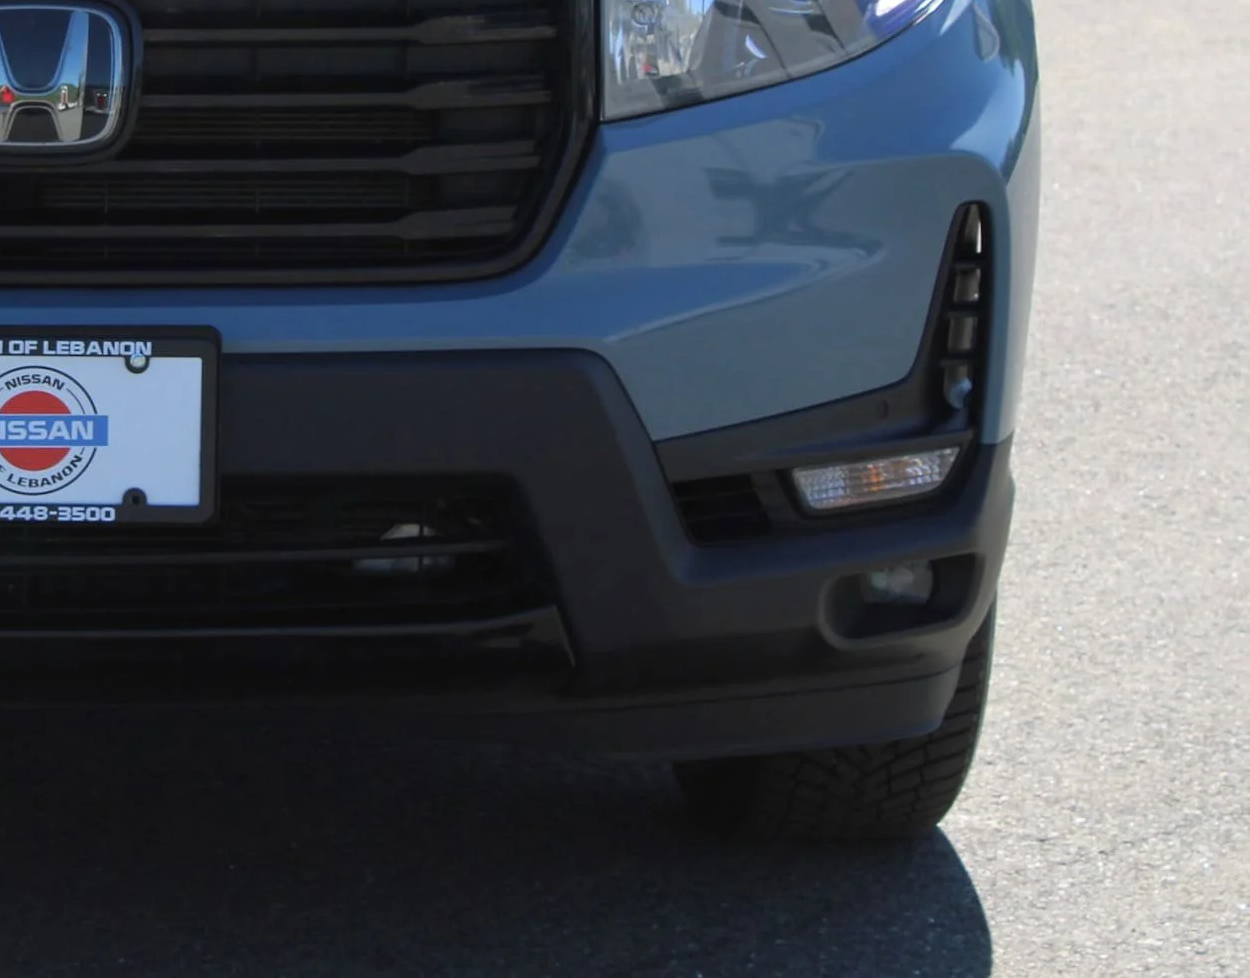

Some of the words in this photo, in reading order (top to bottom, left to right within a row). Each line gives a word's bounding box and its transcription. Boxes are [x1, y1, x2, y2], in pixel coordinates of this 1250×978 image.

[8, 340, 38, 355] OF
[43, 341, 152, 356] LEBANON
[4, 374, 65, 391] NISSAN
[7, 455, 83, 488] LEBANON
